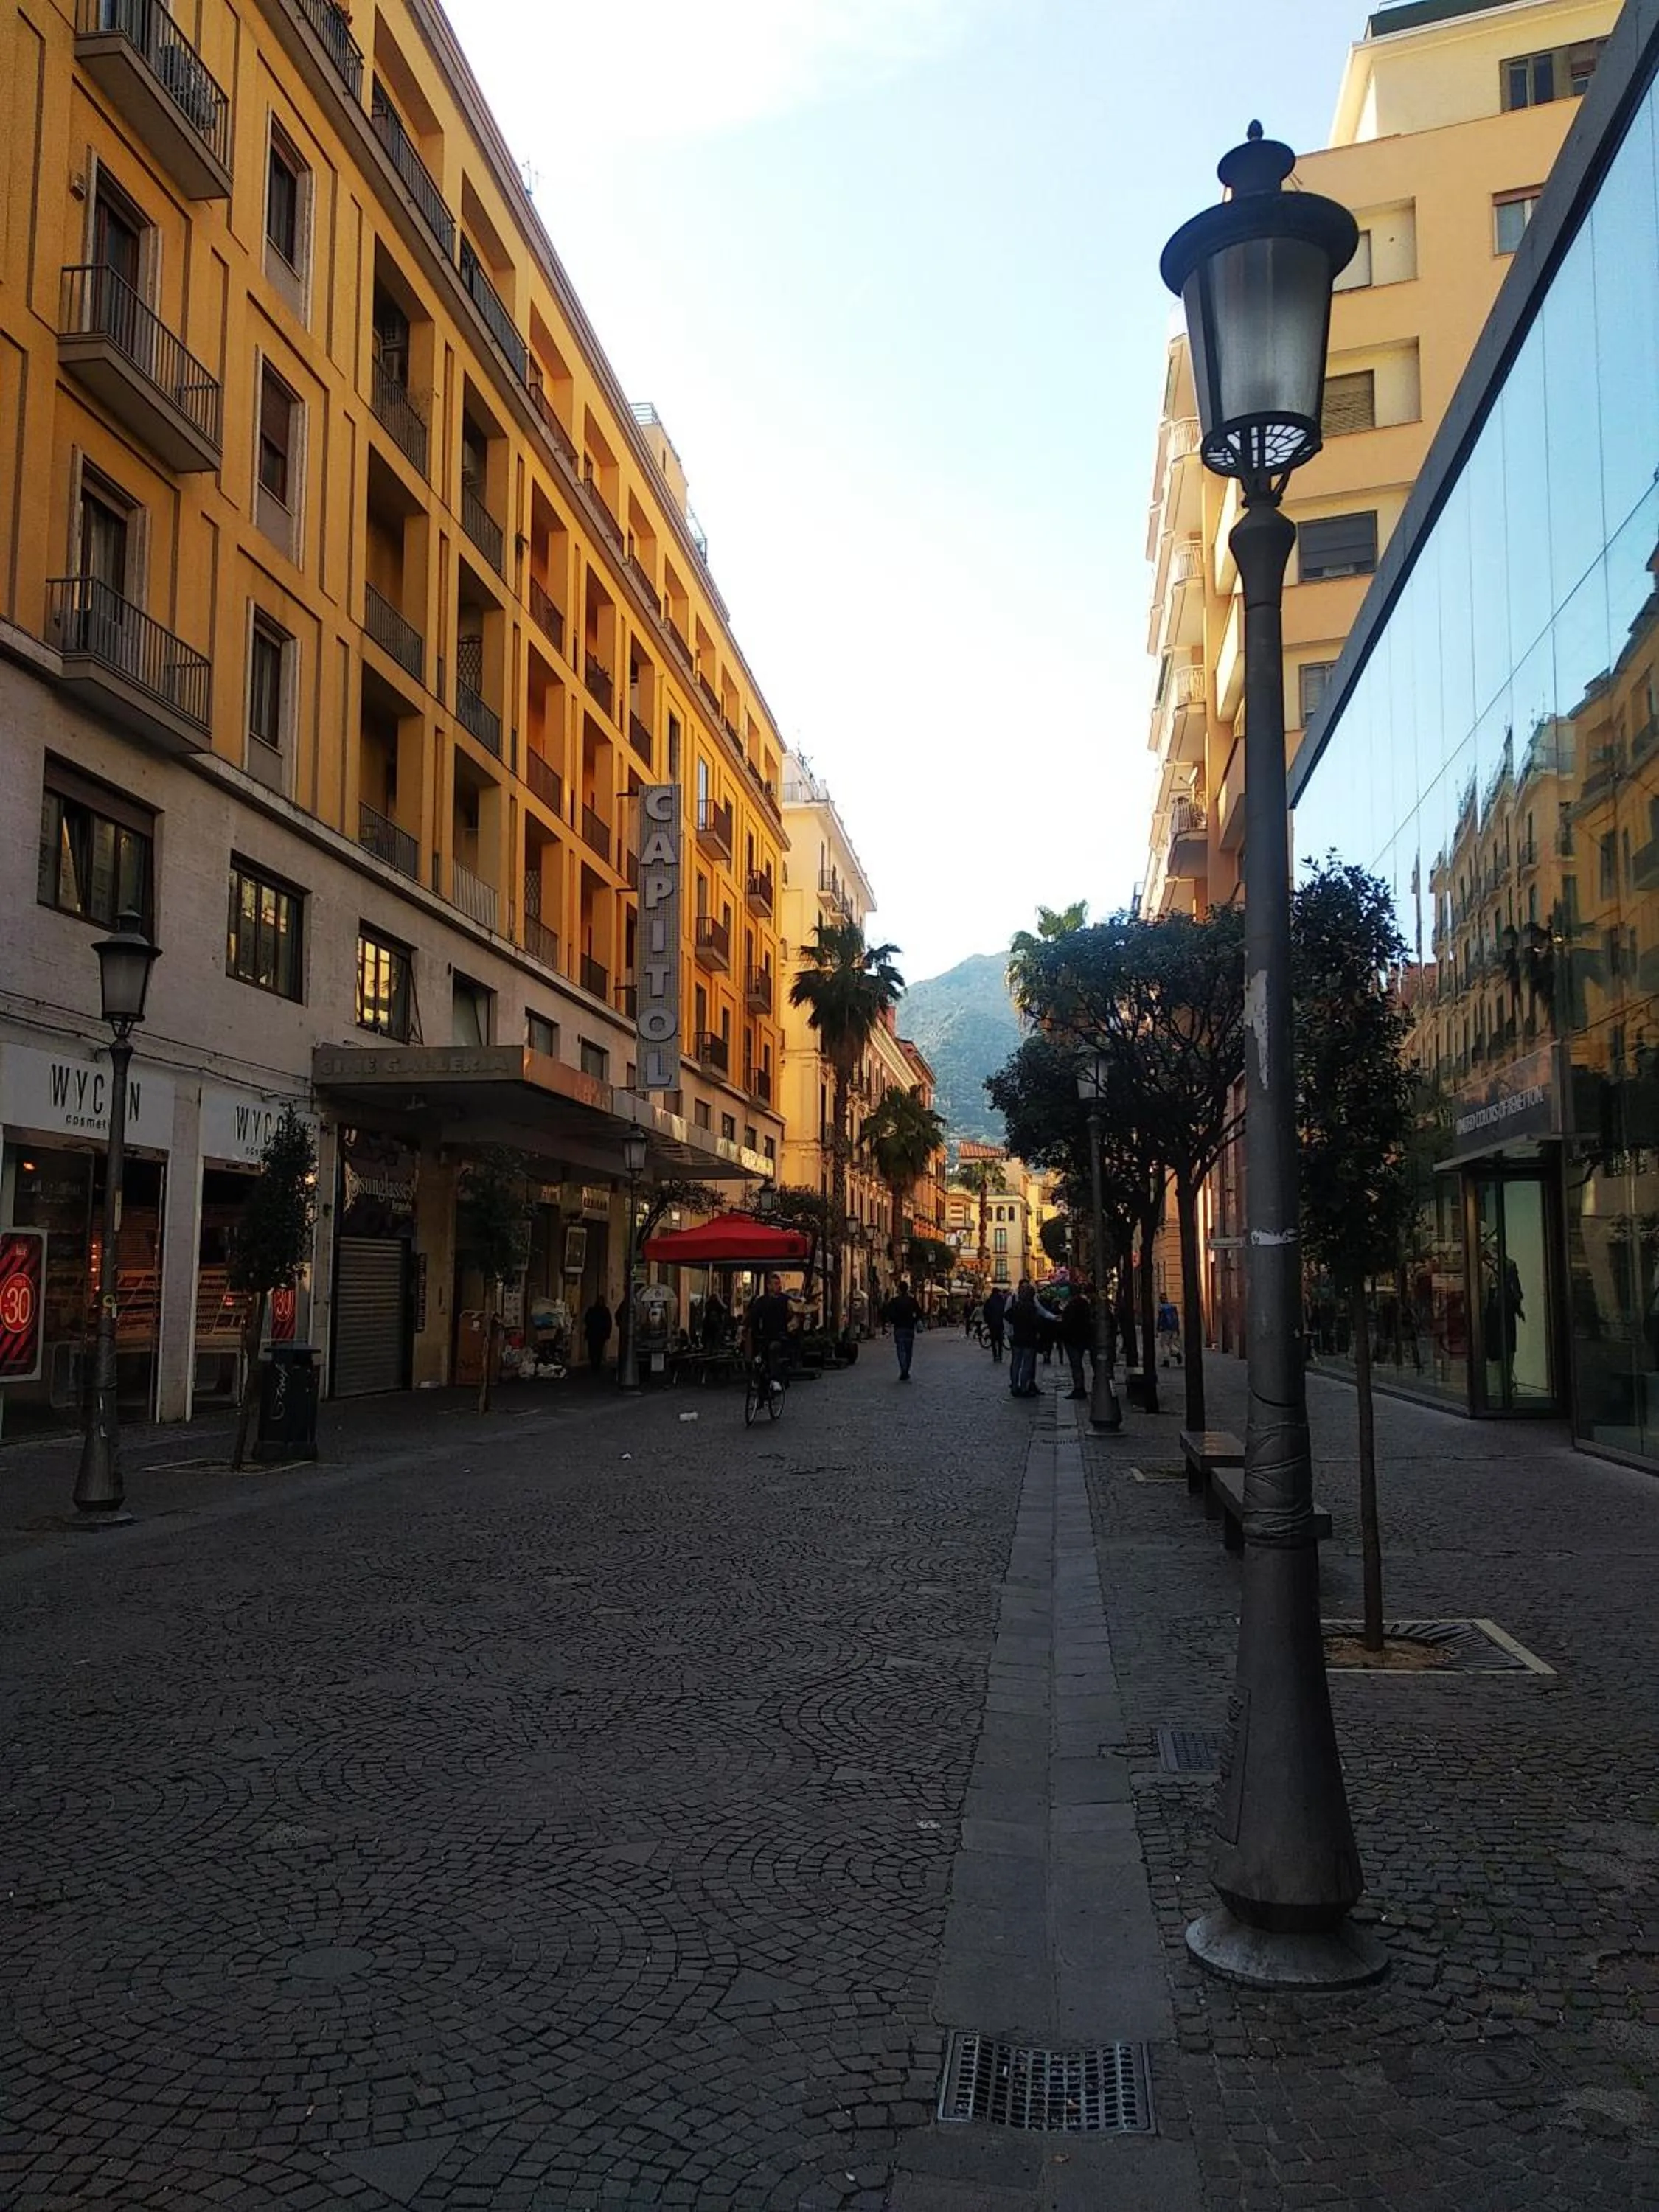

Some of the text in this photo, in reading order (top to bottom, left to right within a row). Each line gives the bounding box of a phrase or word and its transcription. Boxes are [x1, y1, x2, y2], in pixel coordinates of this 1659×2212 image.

[639, 787, 678, 1087] CAPITOL
[384, 1055, 509, 1074] GALLERIA
[50, 1063, 141, 1121] WYCN
[65, 1113, 111, 1130] cosmet
